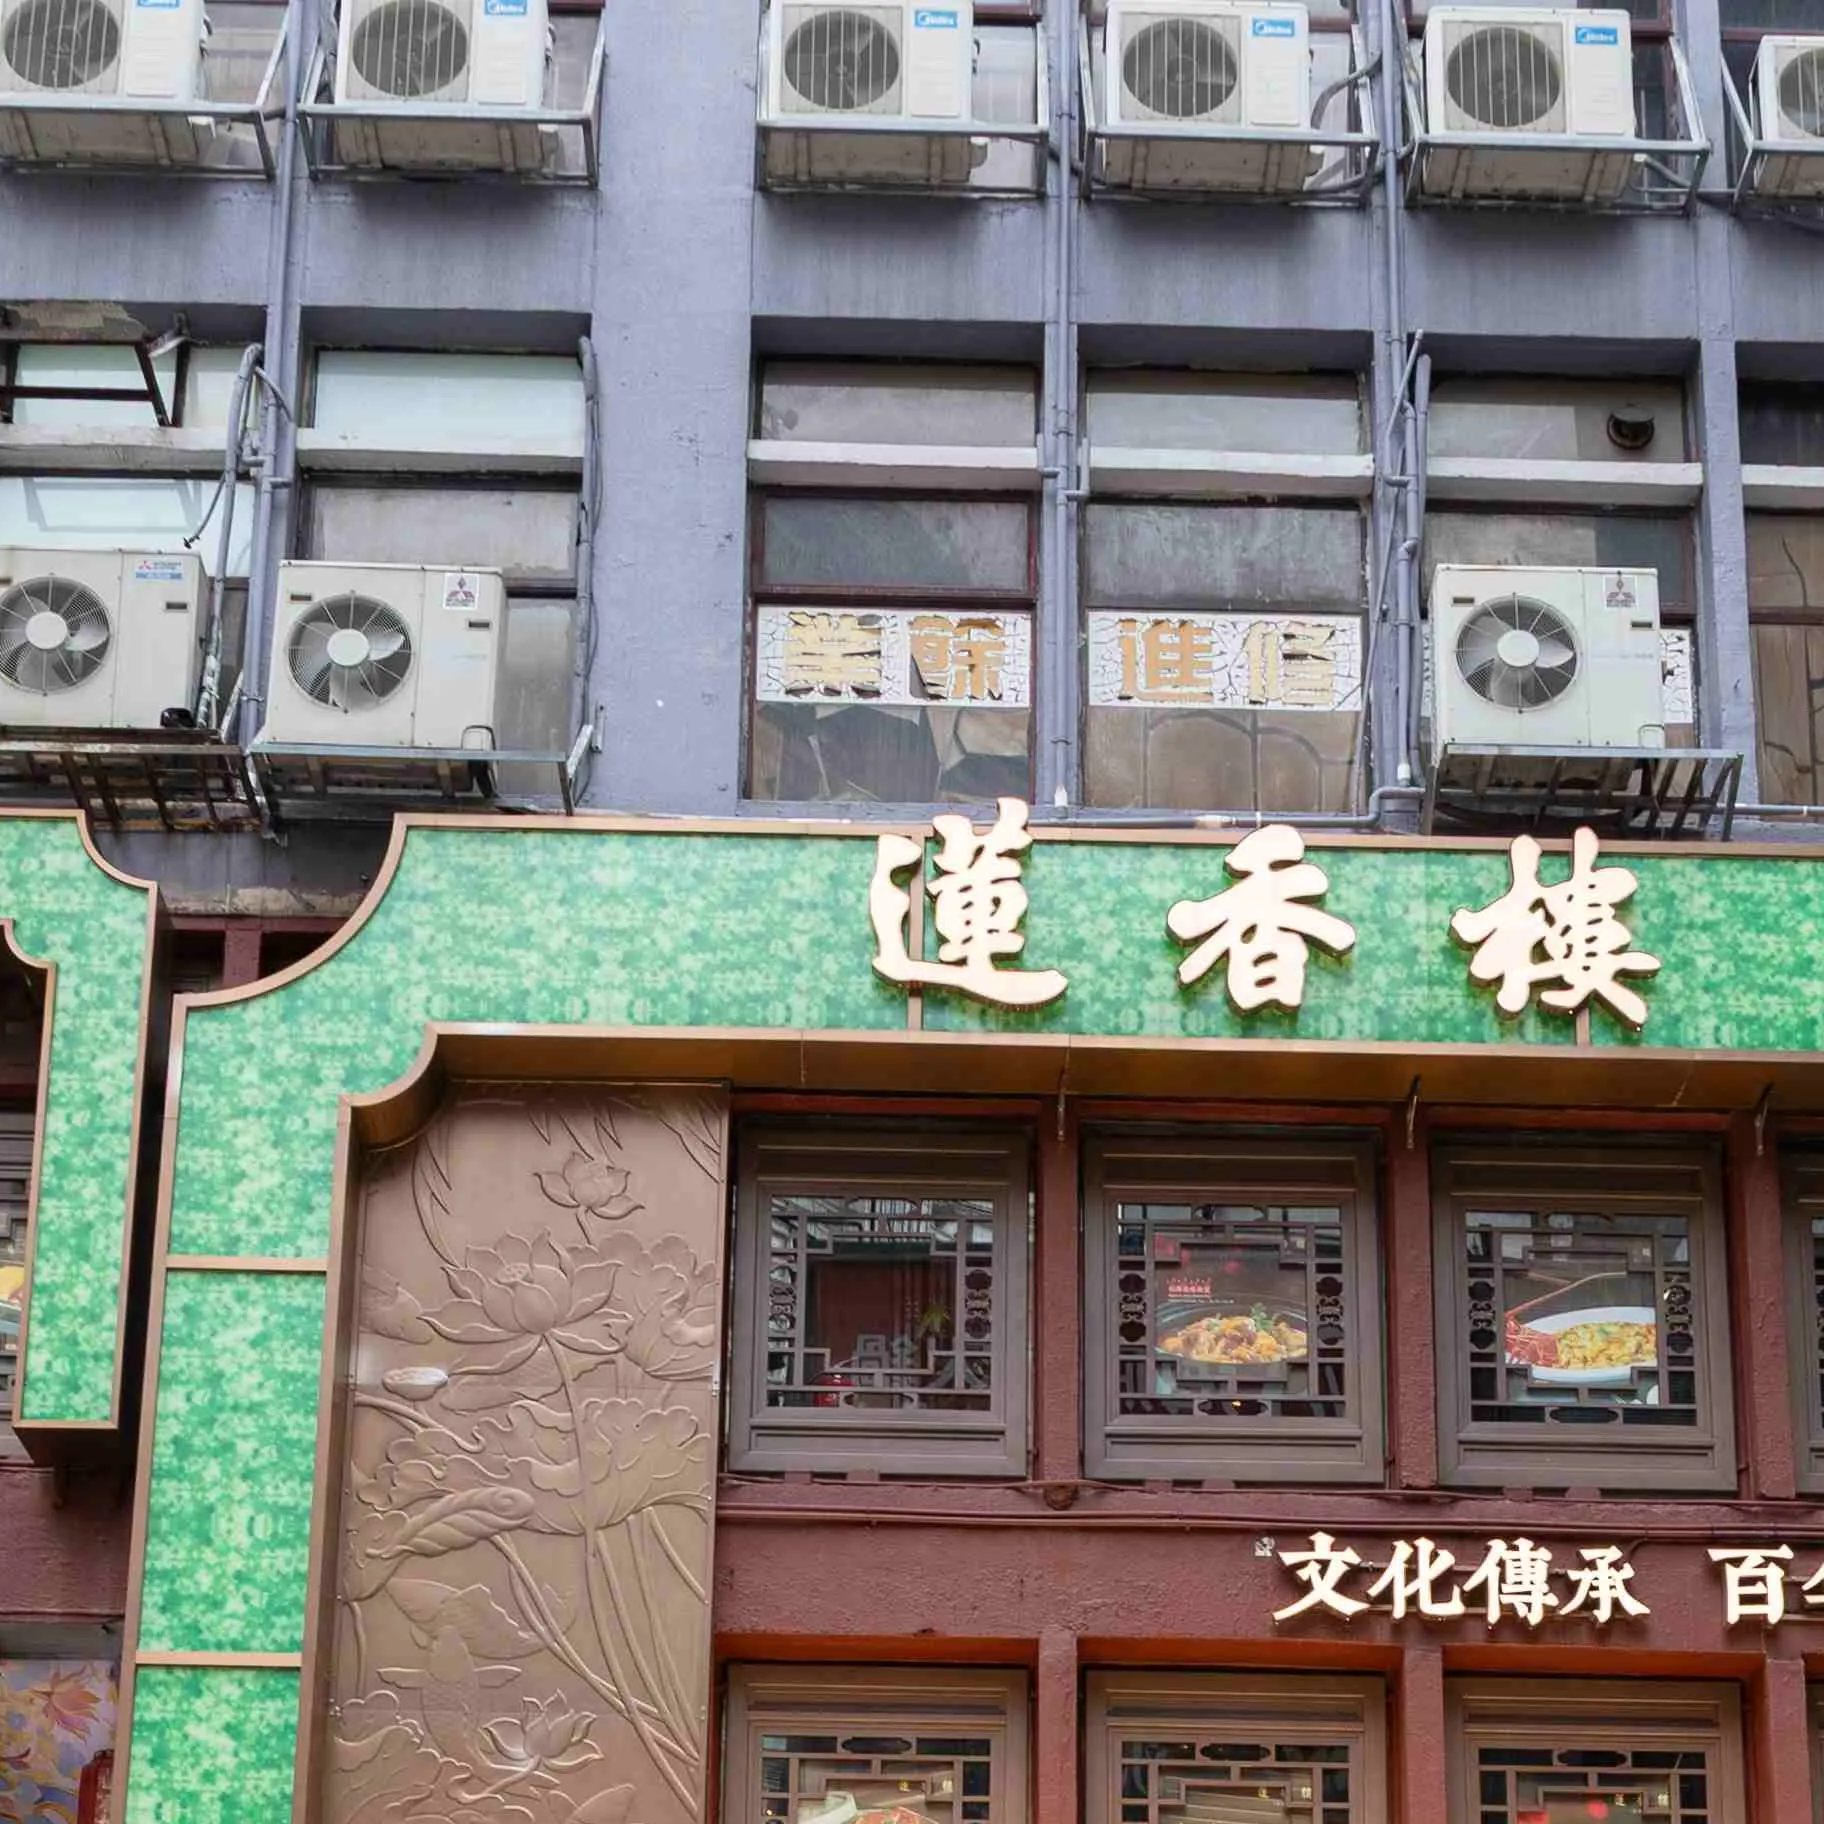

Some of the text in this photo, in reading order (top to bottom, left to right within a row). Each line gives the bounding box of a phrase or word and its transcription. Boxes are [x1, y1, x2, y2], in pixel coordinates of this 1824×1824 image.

[869, 796, 1662, 1031] 蓮香樓
[1273, 1530, 1650, 1627] 文化傳承
